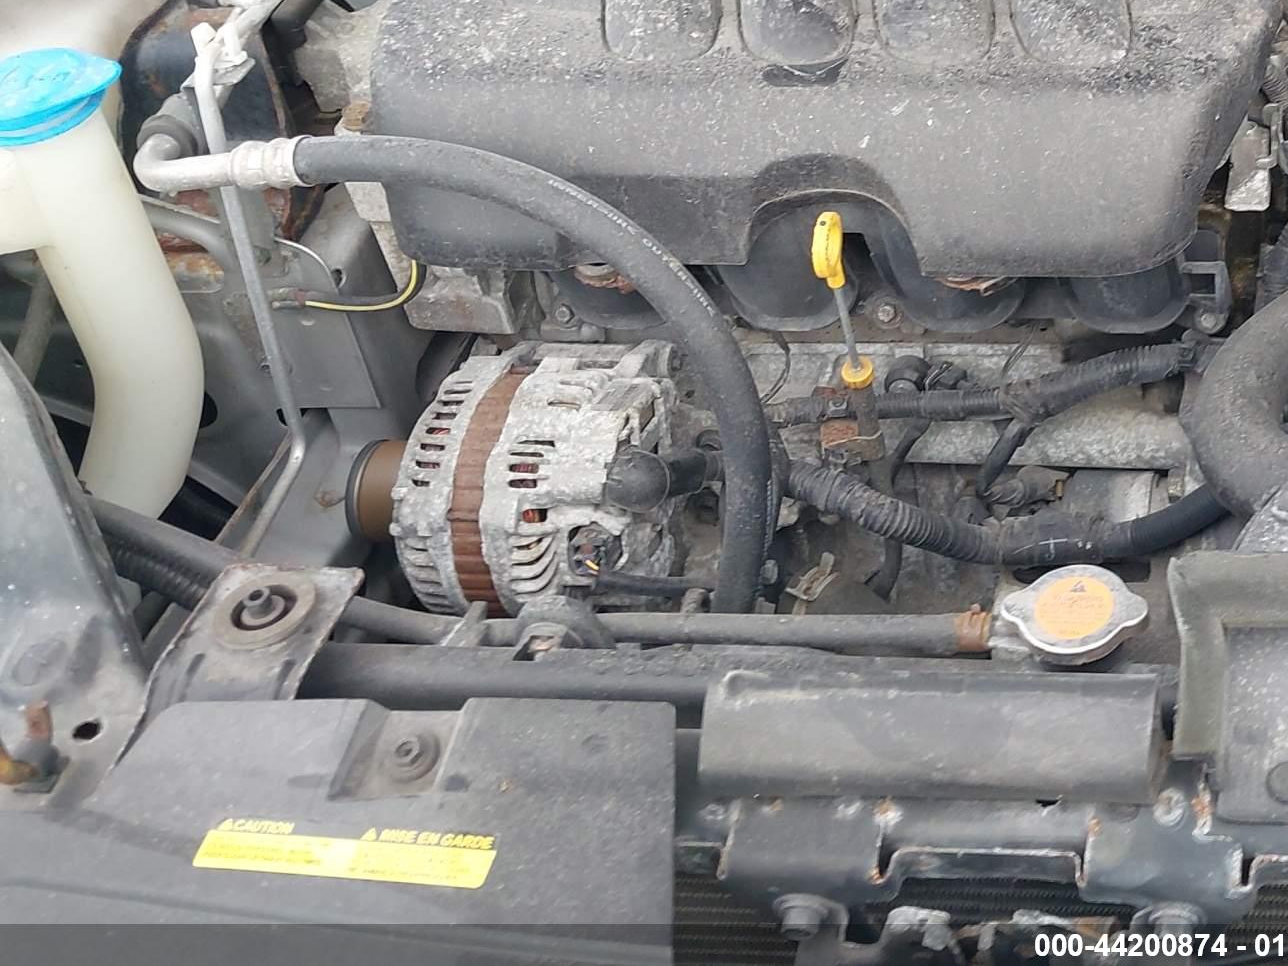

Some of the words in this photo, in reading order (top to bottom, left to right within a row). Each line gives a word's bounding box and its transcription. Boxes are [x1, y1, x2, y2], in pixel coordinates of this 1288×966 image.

[233, 818, 295, 836] CAUTION
[378, 828, 418, 844] MISE
[415, 831, 441, 846] EN
[439, 833, 495, 850] GARDE
